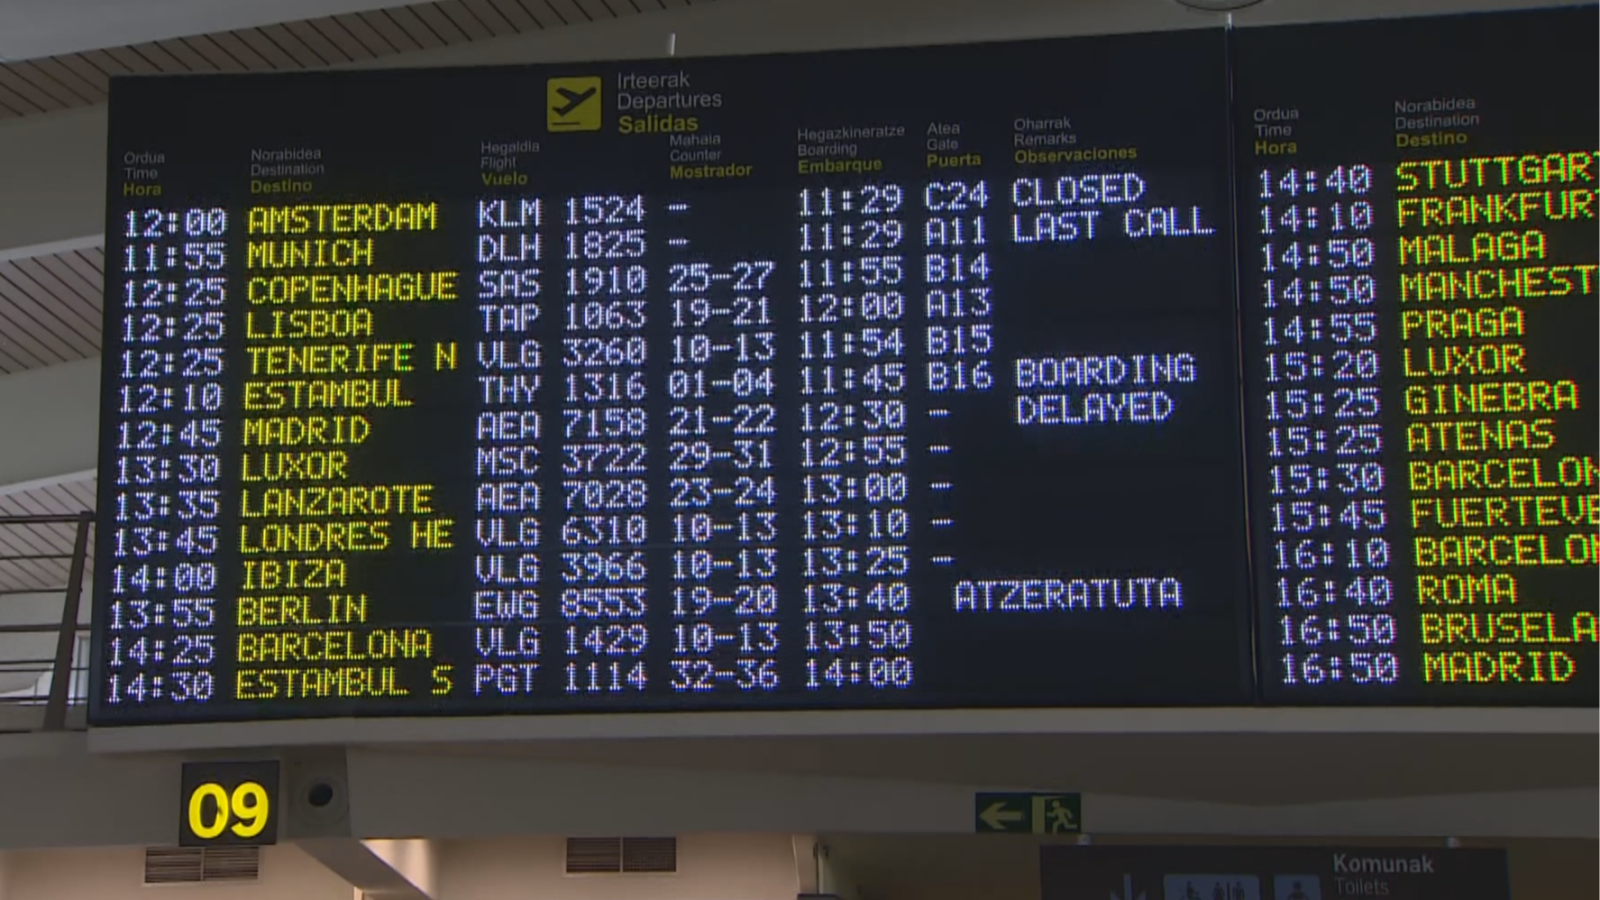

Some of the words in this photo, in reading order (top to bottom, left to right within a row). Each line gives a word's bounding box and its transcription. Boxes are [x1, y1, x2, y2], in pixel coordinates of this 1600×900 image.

[617, 72, 690, 89] Irteerak
[616, 91, 722, 112] Departures
[1394, 98, 1476, 114] Norabidea
[618, 115, 698, 133] Salidas
[1013, 117, 1071, 131] Oharrak
[1253, 108, 1299, 121] Ordua
[1395, 114, 1480, 129] Destination
[797, 124, 905, 143] Hegazkineratze
[927, 122, 960, 135] Atea
[1254, 124, 1292, 136] Time
[480, 140, 540, 155] Hegaldia
[669, 133, 721, 147] Mahaia
[926, 138, 958, 151] Gate
[1014, 133, 1076, 146] Remarks
[1255, 140, 1298, 155] Hora
[1396, 131, 1468, 147] Destino
[123, 151, 166, 165] Ordua
[250, 148, 322, 161] Norabidea
[669, 149, 721, 162] Counter
[797, 143, 857, 158] Boarding
[1014, 147, 1137, 165] Observaciones
[250, 163, 325, 176] Destination
[480, 156, 517, 171] Flight
[797, 158, 883, 175] Embarque
[926, 154, 981, 168] Puerta
[124, 166, 158, 180] Time
[481, 172, 528, 186] Vuelo
[669, 164, 753, 180] Mostrador
[1259, 164, 1372, 199] 14:40
[1396, 150, 1600, 191] STUTTGAR
[123, 183, 162, 196] Hora
[250, 179, 313, 194] Destino
[125, 207, 227, 238] 12:00
[248, 201, 437, 235] AMSTERDAM
[477, 197, 541, 229] KLM
[566, 194, 646, 226] 1524
[799, 183, 904, 217] 11:29
[925, 180, 990, 212] C24
[1012, 172, 1147, 208] CLOSED
[1260, 200, 1373, 235] 14:10
[1397, 188, 1600, 228] FRANKFUR
[124, 241, 225, 273] 11:55
[247, 237, 373, 269] MUNICH
[477, 232, 541, 264] DLH
[566, 228, 647, 260] 1825
[800, 219, 904, 252] 11:29
[925, 215, 987, 247] A11
[1013, 210, 1102, 244] LAST
[1124, 205, 1216, 238] CALL
[1262, 237, 1375, 273] 14:50
[1399, 229, 1547, 266] MALAGA
[124, 277, 227, 309] 12:25
[248, 271, 458, 305] COPENHAGUE
[478, 268, 541, 299] SAS
[566, 264, 648, 296] 1910
[668, 260, 776, 293] 25-27
[799, 255, 905, 289] 11:55
[925, 252, 992, 283] B14
[1263, 274, 1377, 309] 14:50
[1400, 264, 1600, 303] MANCHEST
[122, 311, 225, 343] 12:25
[246, 308, 373, 339] LISBOA
[478, 303, 541, 334] TAP
[566, 299, 647, 331] 1063
[672, 295, 771, 328] 19-21
[800, 290, 905, 323] 12:00
[926, 286, 993, 319] A13
[1264, 311, 1378, 346] 14:55
[1401, 306, 1525, 341] PRAGA
[121, 347, 224, 379] 12:25
[246, 343, 413, 375] TENERIFE
[435, 342, 457, 371] N
[477, 339, 541, 370] VLG
[562, 335, 647, 368] 3260
[672, 331, 776, 364] 10-13
[800, 327, 906, 360] 11:54
[927, 323, 994, 356] B15
[1265, 349, 1380, 383] 15:20
[1403, 343, 1527, 377] LUXOR
[119, 382, 223, 414] 12:10
[244, 378, 412, 411] ESTAMBUL
[478, 374, 541, 404] THY
[566, 371, 647, 403] 1316
[667, 367, 776, 400] 01-04
[801, 362, 906, 396] 11:45
[928, 359, 995, 392] B16
[1016, 352, 1197, 389] BOARDING
[1266, 387, 1381, 421] 15:25
[1404, 379, 1580, 415] GINEBRA
[118, 418, 221, 451] 12:45
[243, 415, 370, 447] MADRID
[476, 410, 541, 441] AEA
[562, 407, 648, 439] 7158
[669, 403, 777, 436] 21-22
[801, 399, 907, 433] 12:30
[1017, 390, 1175, 425] DELAYED
[1268, 423, 1383, 458] 15:25
[1407, 418, 1556, 453] ATENAS
[116, 454, 220, 486] 13:30
[242, 450, 348, 482] LUXOR
[475, 445, 540, 477] MSC
[562, 442, 648, 476] 3722
[669, 439, 773, 472] 29-31
[801, 435, 908, 469] 12:55
[1270, 462, 1385, 497] 15:30
[115, 489, 220, 522] 13:35
[241, 484, 433, 518] LANZAROTE
[476, 481, 541, 514] AEA
[562, 479, 648, 512] 7028
[669, 475, 778, 509] 23-24
[803, 472, 909, 506] 13:00
[1272, 499, 1387, 533] 15:45
[114, 525, 218, 558] 13:45
[240, 520, 389, 554] LONDRES
[412, 519, 453, 549] HE
[475, 517, 540, 550] VLG
[561, 514, 647, 548] 6310
[673, 511, 778, 544] 10-13
[803, 508, 910, 542] 13:10
[1275, 537, 1390, 570] 16:10
[112, 562, 216, 594] 14:00
[242, 558, 346, 590] IBIZA
[475, 553, 540, 586] VLG
[560, 551, 647, 584] 3966
[672, 548, 778, 582] 10-13
[803, 545, 910, 578] 13:25
[1277, 575, 1394, 609] 16:40
[1416, 573, 1518, 605] ROMA
[110, 598, 216, 631] 13:55
[237, 593, 367, 626] BERLIN
[474, 589, 539, 623] EWG
[560, 587, 647, 619] 8553
[672, 584, 778, 618] 19-20
[804, 581, 911, 616] 13:40
[955, 577, 1184, 613] ATZERATUTA
[1280, 613, 1397, 647] 16:50
[1421, 611, 1600, 644] BRUSELA
[110, 634, 215, 667] 14:25
[238, 629, 432, 662] BARCELONA
[475, 626, 540, 659] VLG
[566, 623, 649, 657] 1429
[674, 621, 780, 656] 10-13
[805, 619, 913, 653] 13:50
[1282, 652, 1399, 685] 16:50
[1423, 650, 1576, 682] MADRID
[108, 670, 213, 704] 14:30
[236, 666, 408, 700] ESTAMBUL
[432, 665, 453, 695] S
[474, 663, 538, 696] PGT
[565, 660, 647, 693] 1114
[670, 658, 780, 693] 32-36
[806, 656, 914, 690] 14:00
[187, 781, 269, 839] 09
[1333, 853, 1434, 873] Komunak
[1335, 877, 1390, 895] Toilets
